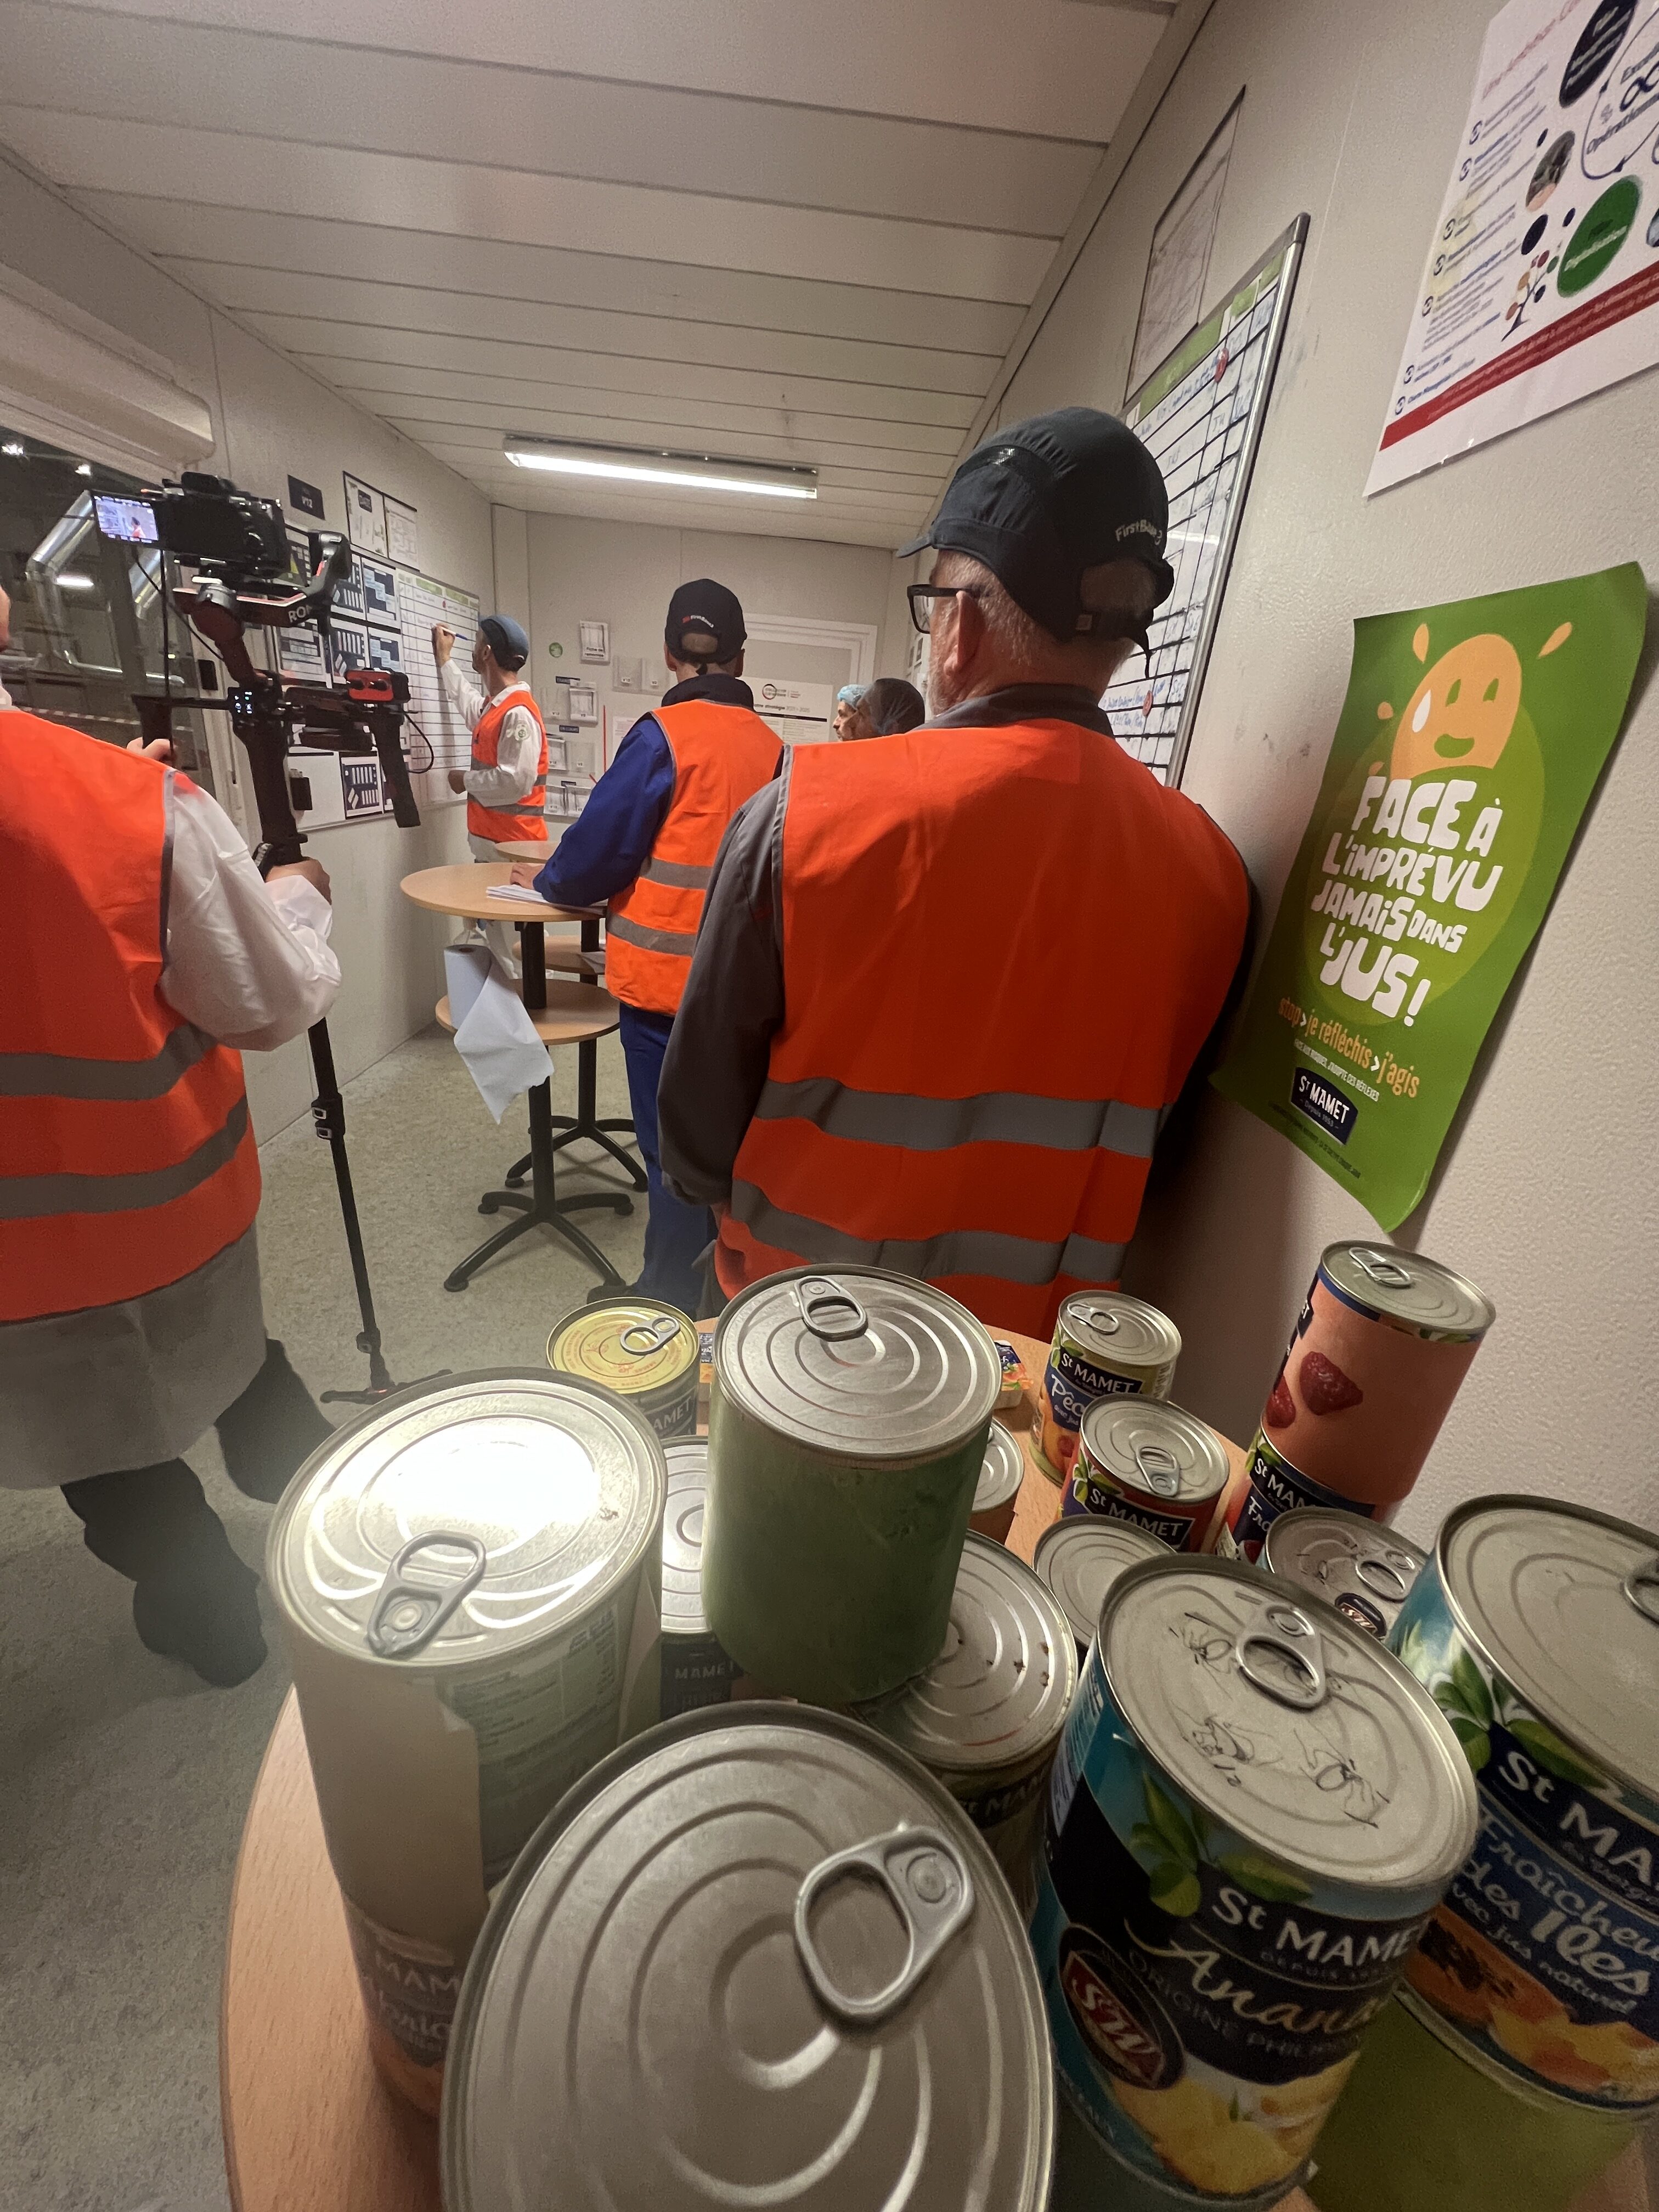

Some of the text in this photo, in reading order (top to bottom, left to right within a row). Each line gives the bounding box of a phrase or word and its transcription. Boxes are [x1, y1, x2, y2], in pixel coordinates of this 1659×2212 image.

[1351, 776, 1503, 857] FACE À
[1407, 909, 1468, 953] DANS
[1278, 996, 1302, 1028] stop
[1304, 1008, 1319, 1037] je
[1318, 1019, 1373, 1069] réfléchis
[1376, 1050, 1420, 1098] j'agis
[1310, 1082, 1350, 1124] MAMET
[1051, 1373, 1086, 1417] Pêc
[1061, 1353, 1073, 1368] St
[1074, 1363, 1135, 1394] MAMET
[653, 1395, 692, 1430] AMET
[1254, 1458, 1268, 1478] St
[1090, 1488, 1183, 1537] St MAMET
[1498, 1751, 1555, 1803] St
[1559, 1801, 1659, 1887] MA
[1482, 1810, 1659, 1961] Fraîcheu
[1211, 1887, 1267, 1930] St
[1487, 1925, 1532, 1960] jus
[375, 1949, 461, 1997] MAM
